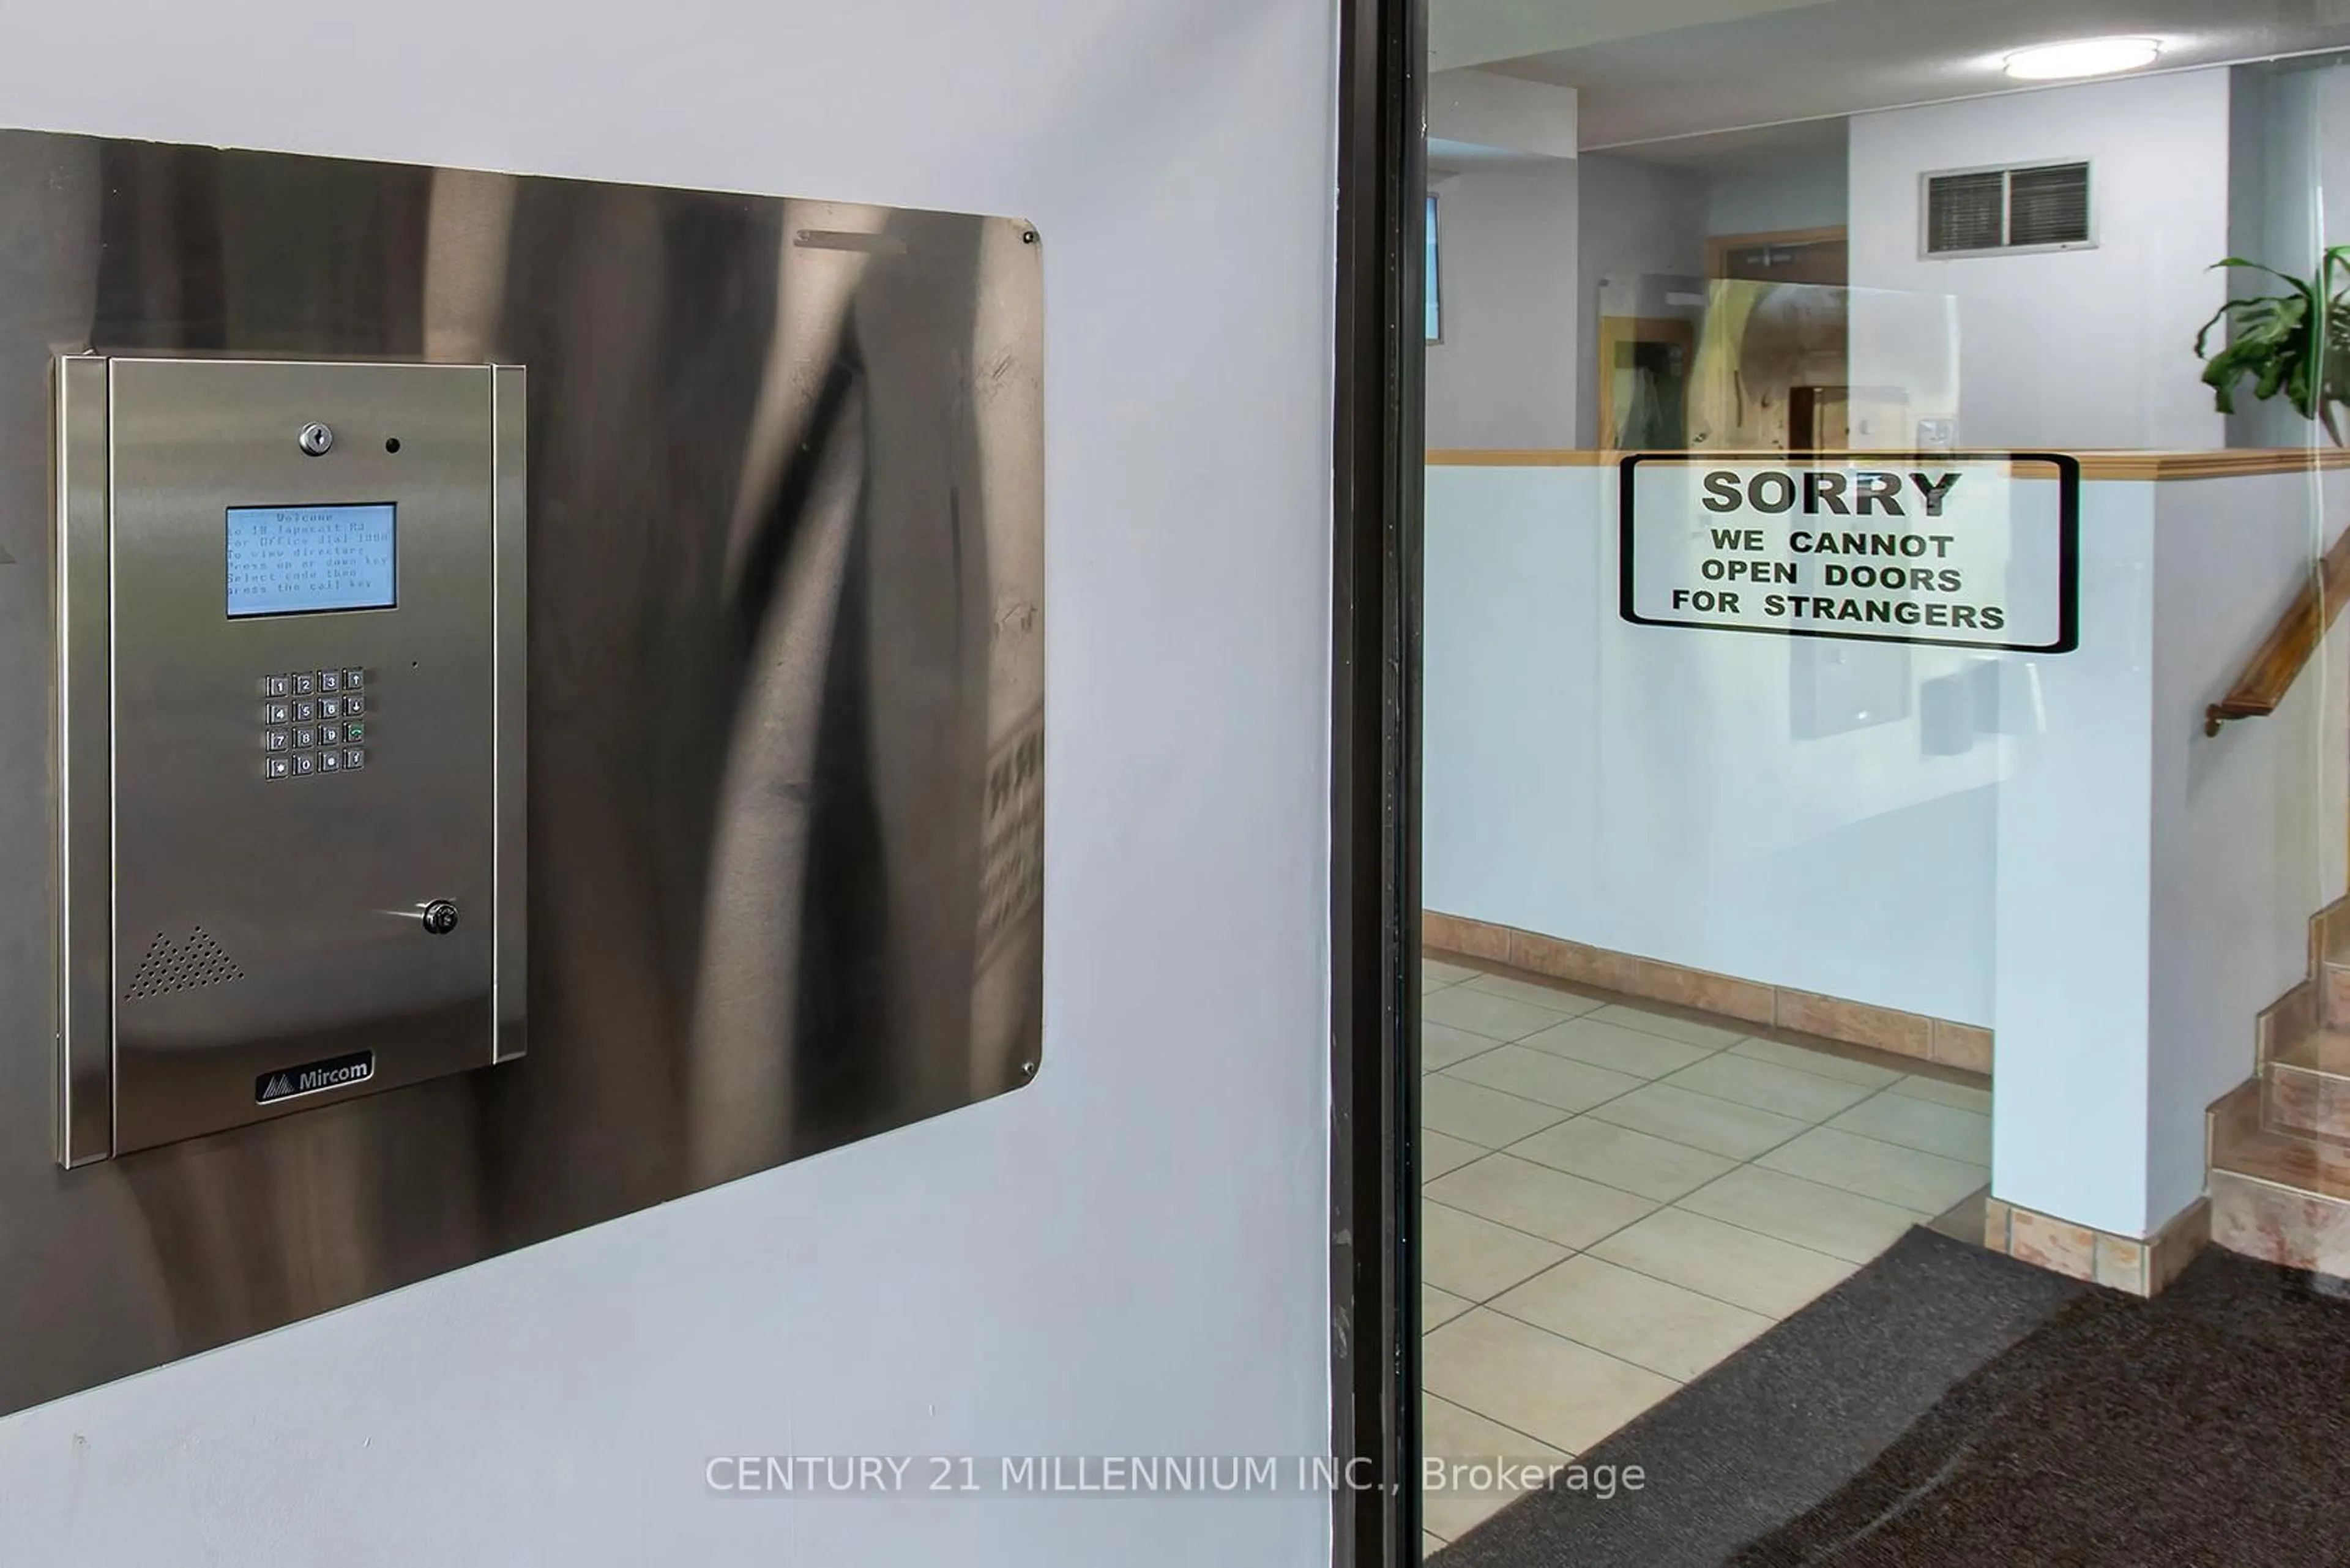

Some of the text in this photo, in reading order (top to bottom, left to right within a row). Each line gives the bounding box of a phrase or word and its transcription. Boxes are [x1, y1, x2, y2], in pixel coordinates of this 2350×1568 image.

[1702, 470, 1962, 517] SORRY
[277, 512, 333, 522] Welcome
[1711, 529, 1954, 558] WE CANNOT
[1701, 559, 1962, 592] OPEN DOORS
[1673, 589, 2005, 630] FOR STRANGERS
[277, 678, 335, 692] 1 2 3
[277, 704, 335, 719] 4 5 6
[277, 736, 285, 745] 7
[302, 733, 310, 742] 8
[302, 760, 310, 769] 0
[300, 1062, 367, 1090] Mircom
